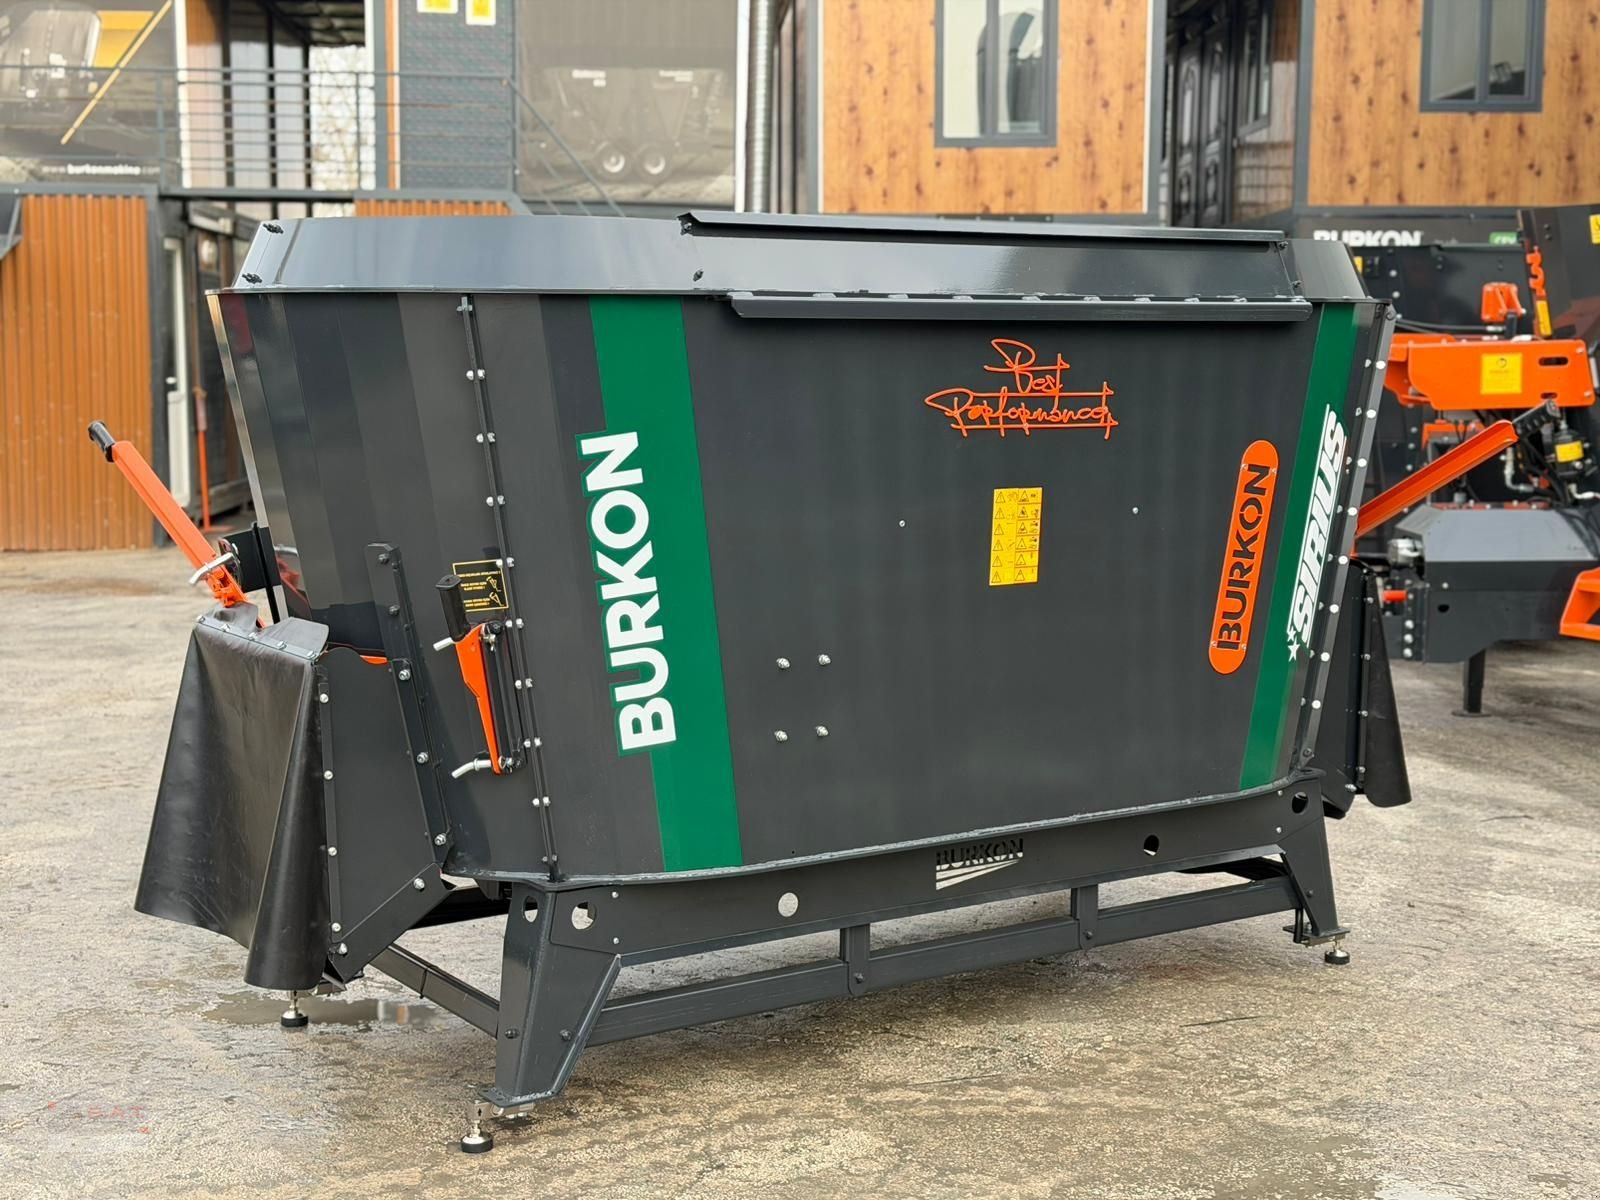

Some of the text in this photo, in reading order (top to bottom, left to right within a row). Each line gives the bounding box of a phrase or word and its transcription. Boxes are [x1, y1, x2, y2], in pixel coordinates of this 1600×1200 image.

[983, 337, 1071, 398] Best
[580, 431, 677, 751] BURKON
[1217, 463, 1271, 651] BURKON
[1293, 409, 1345, 642] SIRIUS
[935, 837, 1025, 872] BURKON
